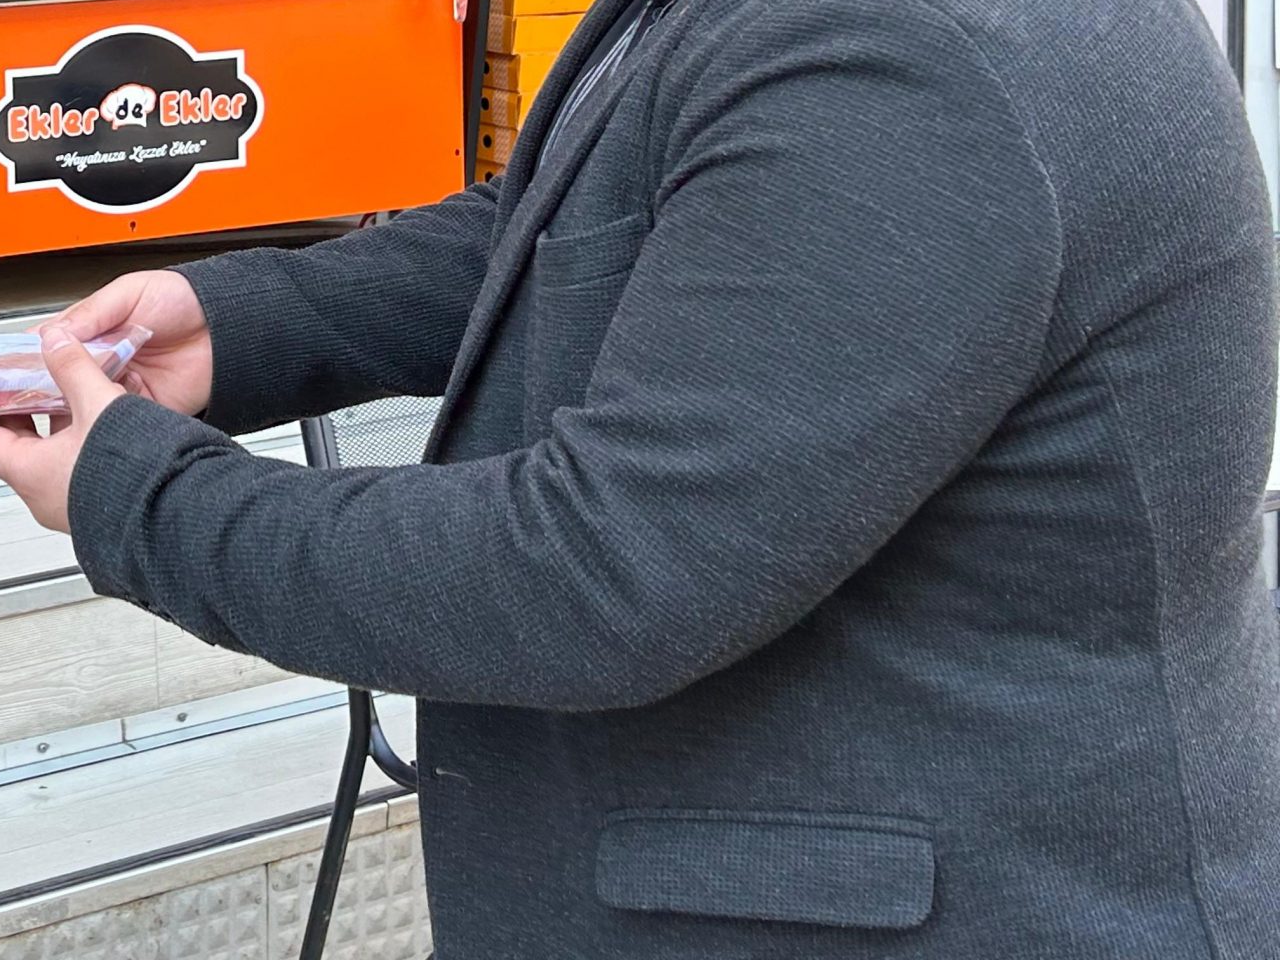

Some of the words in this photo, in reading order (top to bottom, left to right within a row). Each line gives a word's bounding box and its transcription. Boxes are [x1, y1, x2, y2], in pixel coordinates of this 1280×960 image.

[7, 102, 100, 143] Ekler
[115, 98, 144, 120] de
[158, 87, 248, 127] Ekler
